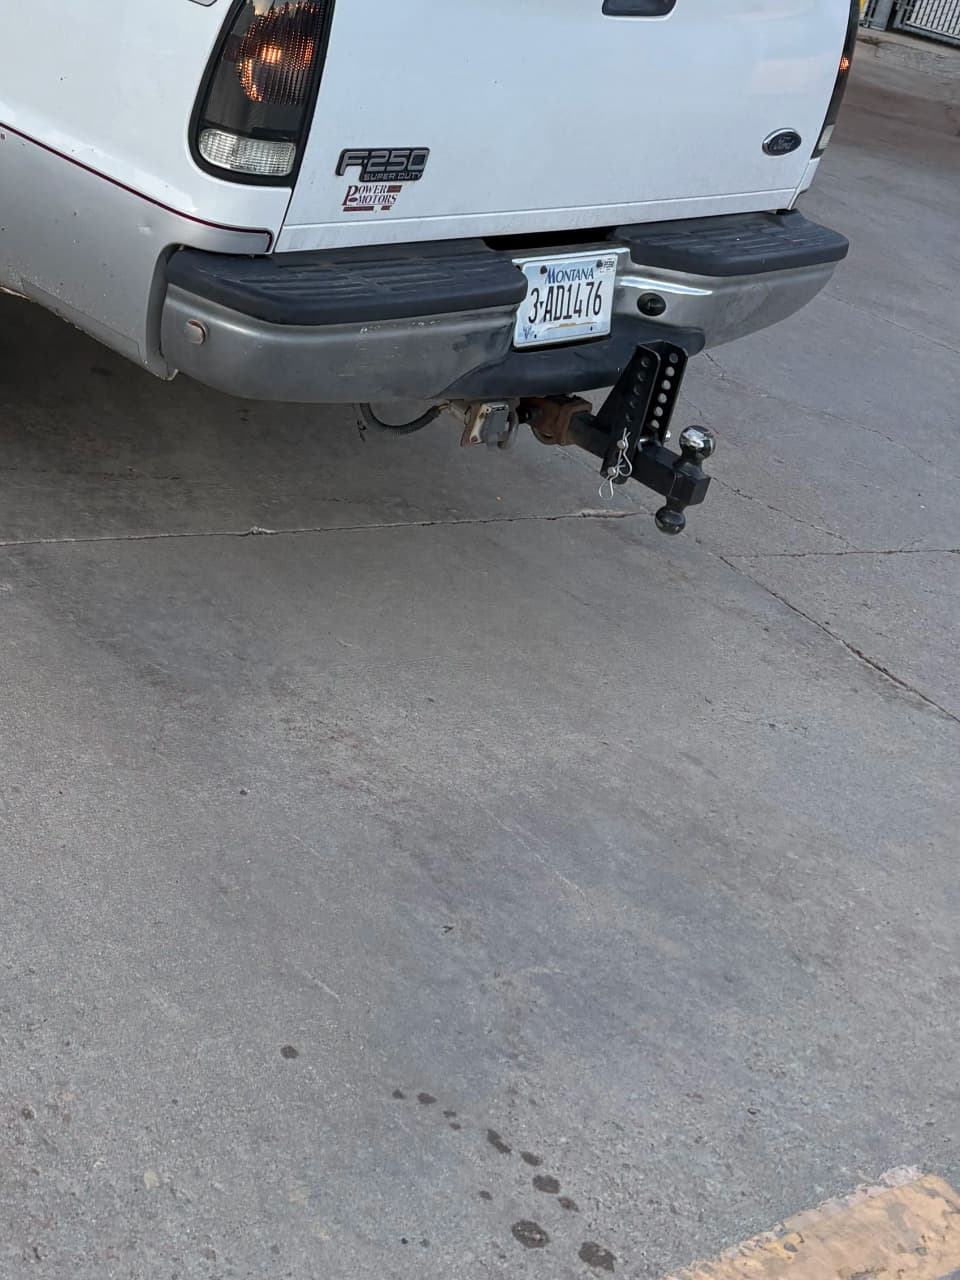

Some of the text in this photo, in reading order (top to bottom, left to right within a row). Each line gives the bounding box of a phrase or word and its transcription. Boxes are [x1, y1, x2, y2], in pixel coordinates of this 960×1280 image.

[363, 170, 424, 181] SUPER DUTY
[357, 193, 398, 205] MOTORS
